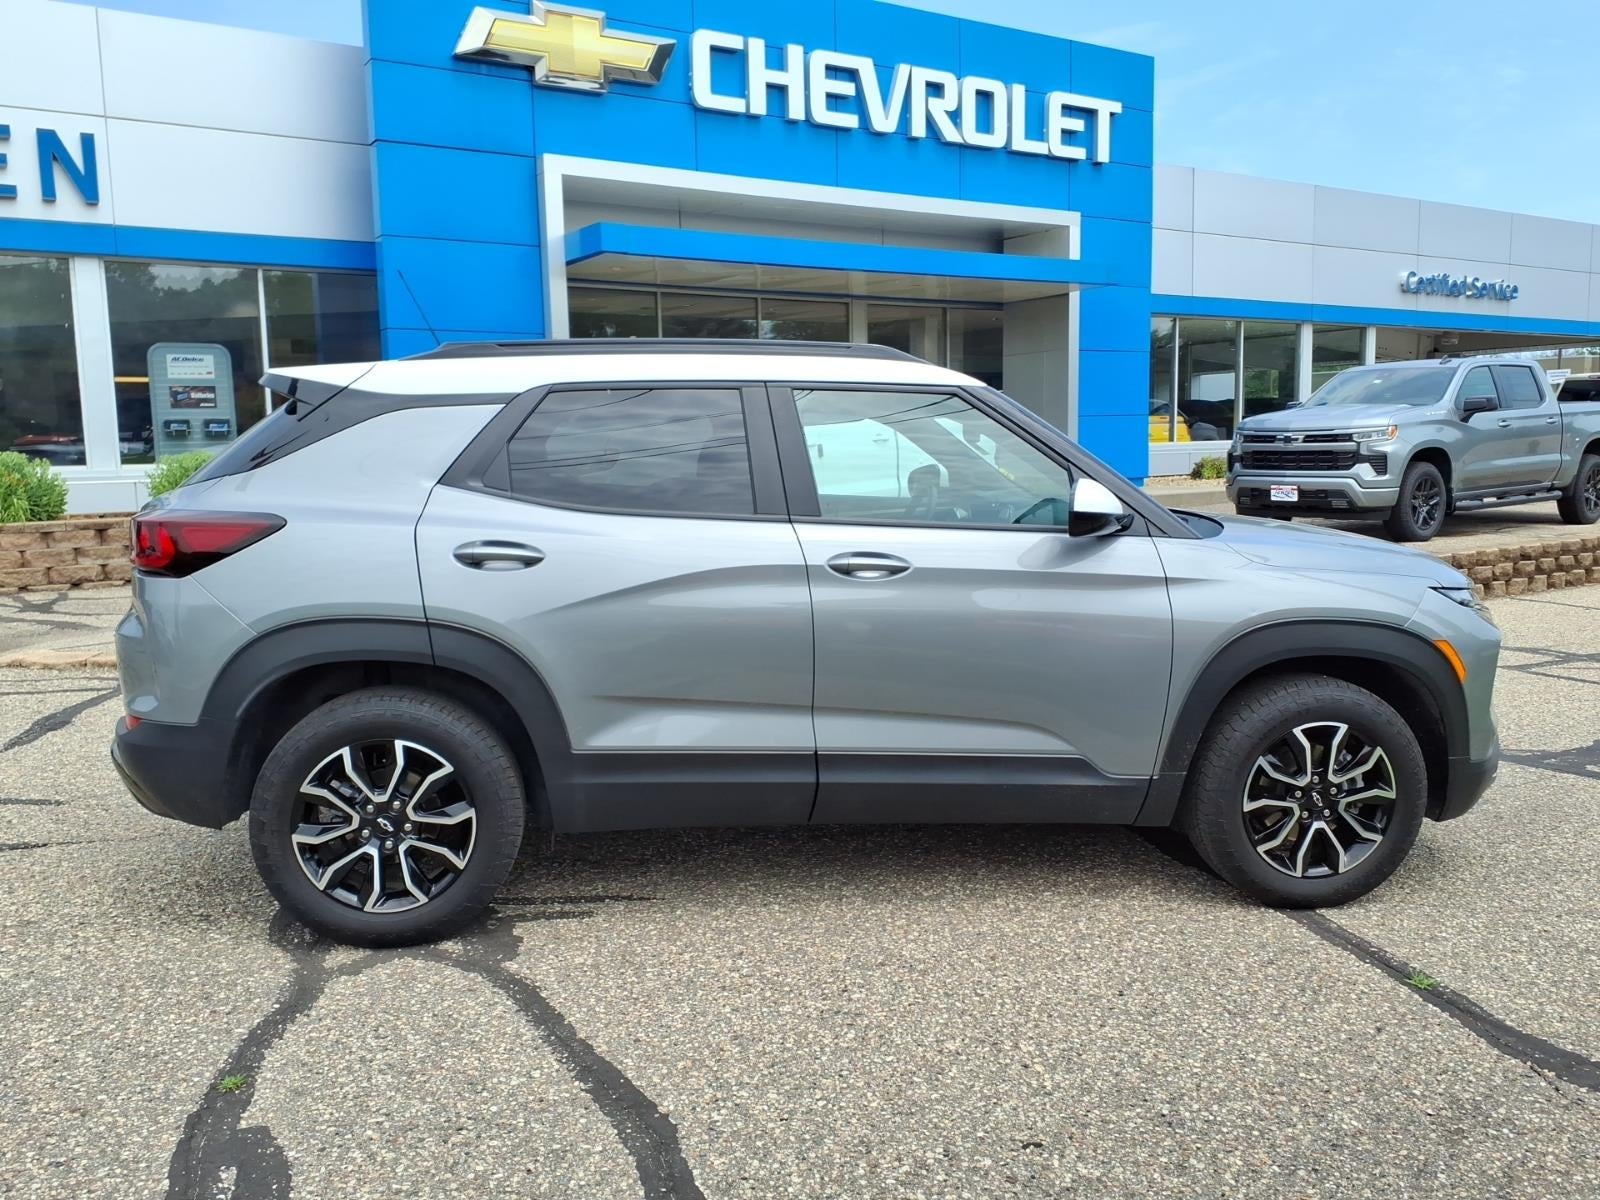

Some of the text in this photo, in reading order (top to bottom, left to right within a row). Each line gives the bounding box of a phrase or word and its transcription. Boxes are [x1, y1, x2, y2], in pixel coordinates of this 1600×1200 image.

[689, 28, 1122, 164] CHEVROLET
[1403, 271, 1518, 301] Certified Service
